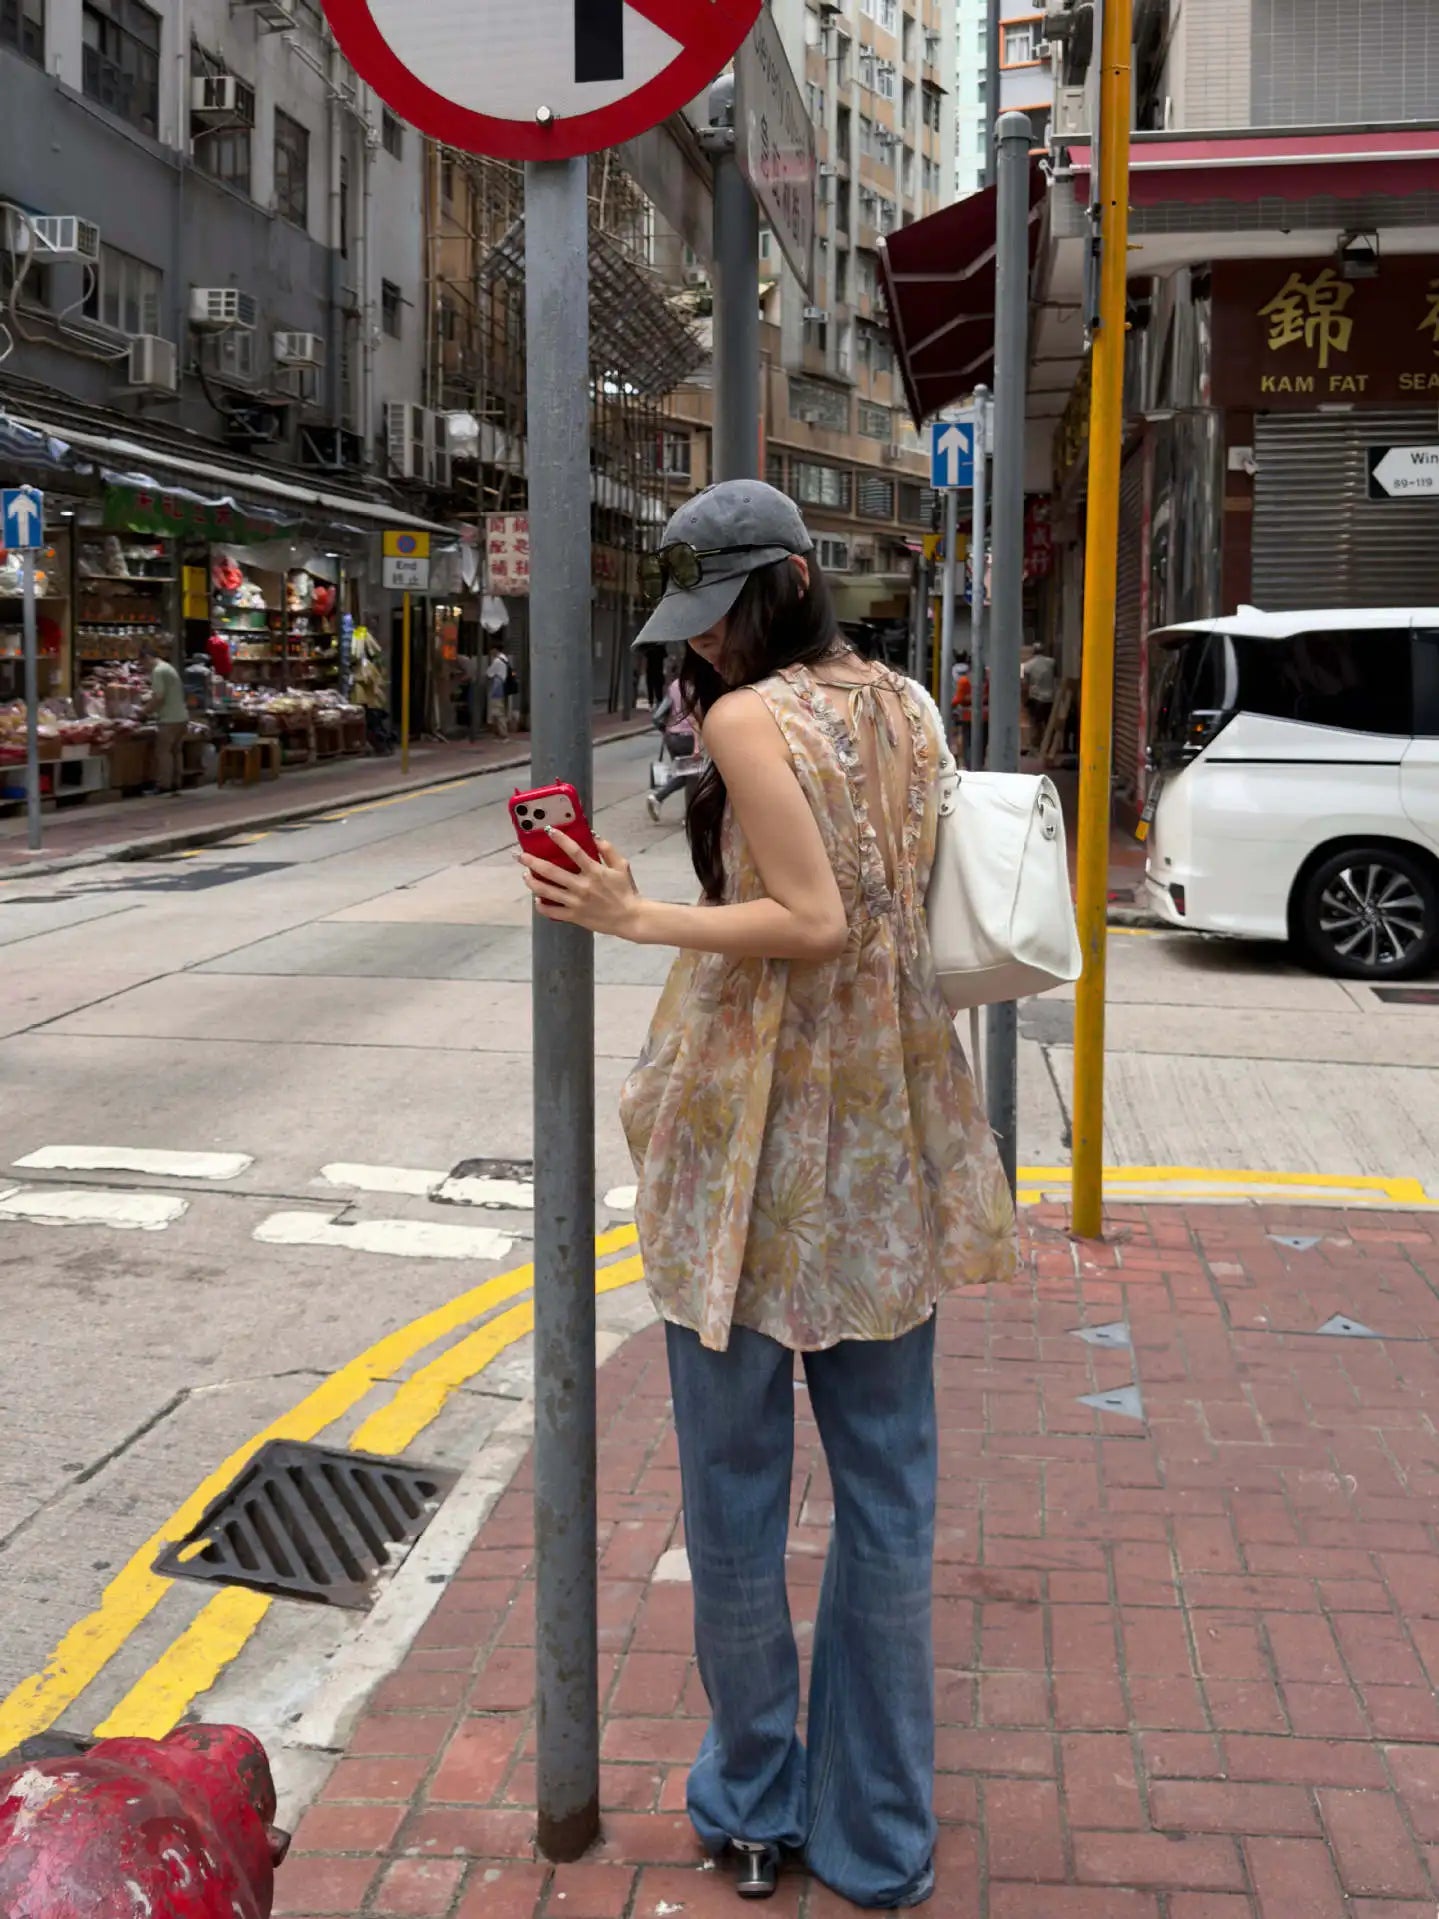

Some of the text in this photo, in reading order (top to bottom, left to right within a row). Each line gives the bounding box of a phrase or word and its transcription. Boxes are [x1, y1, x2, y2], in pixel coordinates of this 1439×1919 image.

[1260, 372, 1439, 393] KAM FAT SEA
[1410, 451, 1439, 465] Win
[396, 560, 417, 571] End
